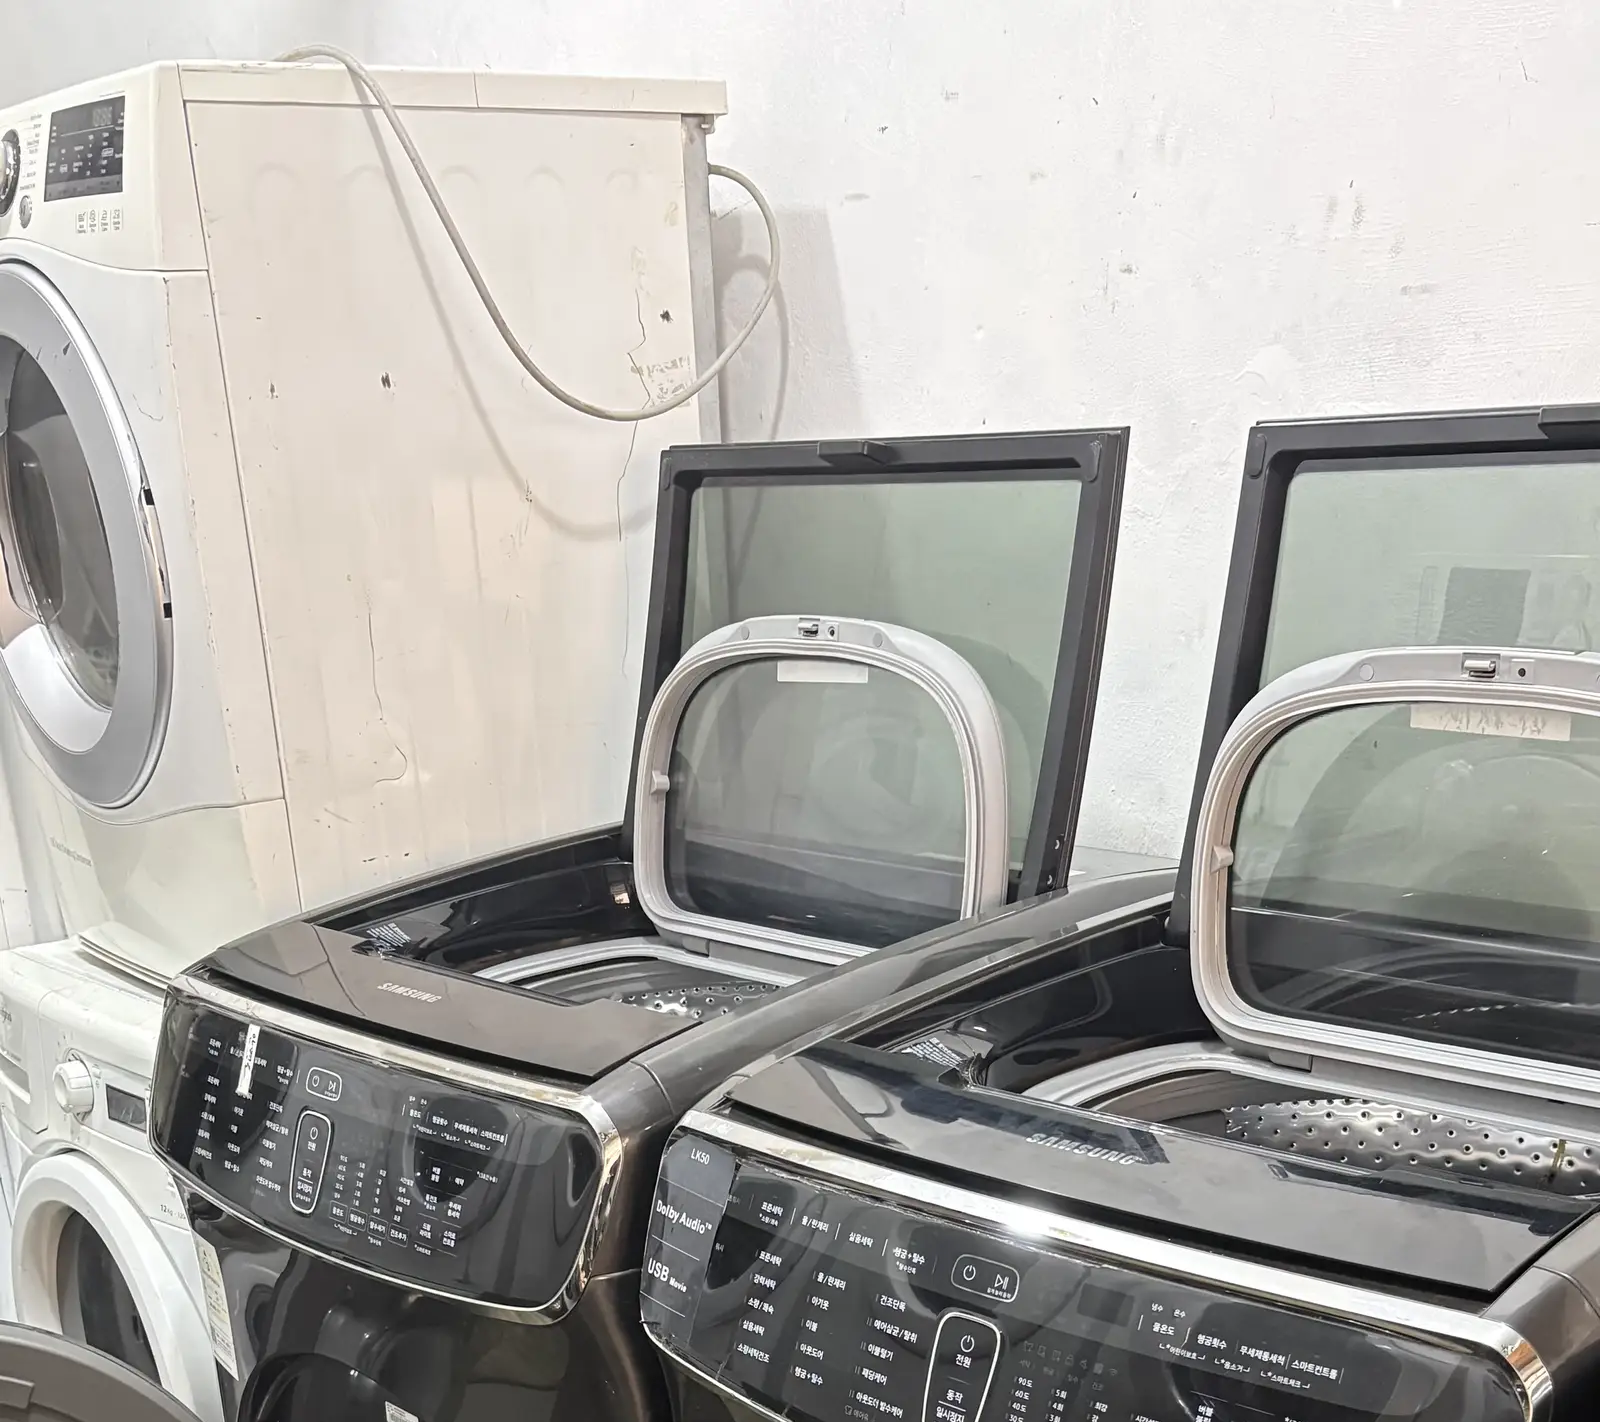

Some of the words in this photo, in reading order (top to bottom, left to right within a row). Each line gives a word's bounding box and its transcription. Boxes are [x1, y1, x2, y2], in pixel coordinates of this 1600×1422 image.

[377, 983, 442, 1003] SAMSUNG
[691, 1148, 710, 1165] LK50
[1026, 1133, 1143, 1165] SAMSUNG
[656, 1200, 680, 1224] Dolby
[647, 1257, 670, 1282] USB
[669, 1276, 687, 1293] Movie
[956, 1354, 972, 1368] 전원
[1018, 1377, 1033, 1388] 90도
[946, 1389, 963, 1404] 동작
[1014, 1389, 1030, 1400] 60도
[1012, 1402, 1027, 1413] 40도
